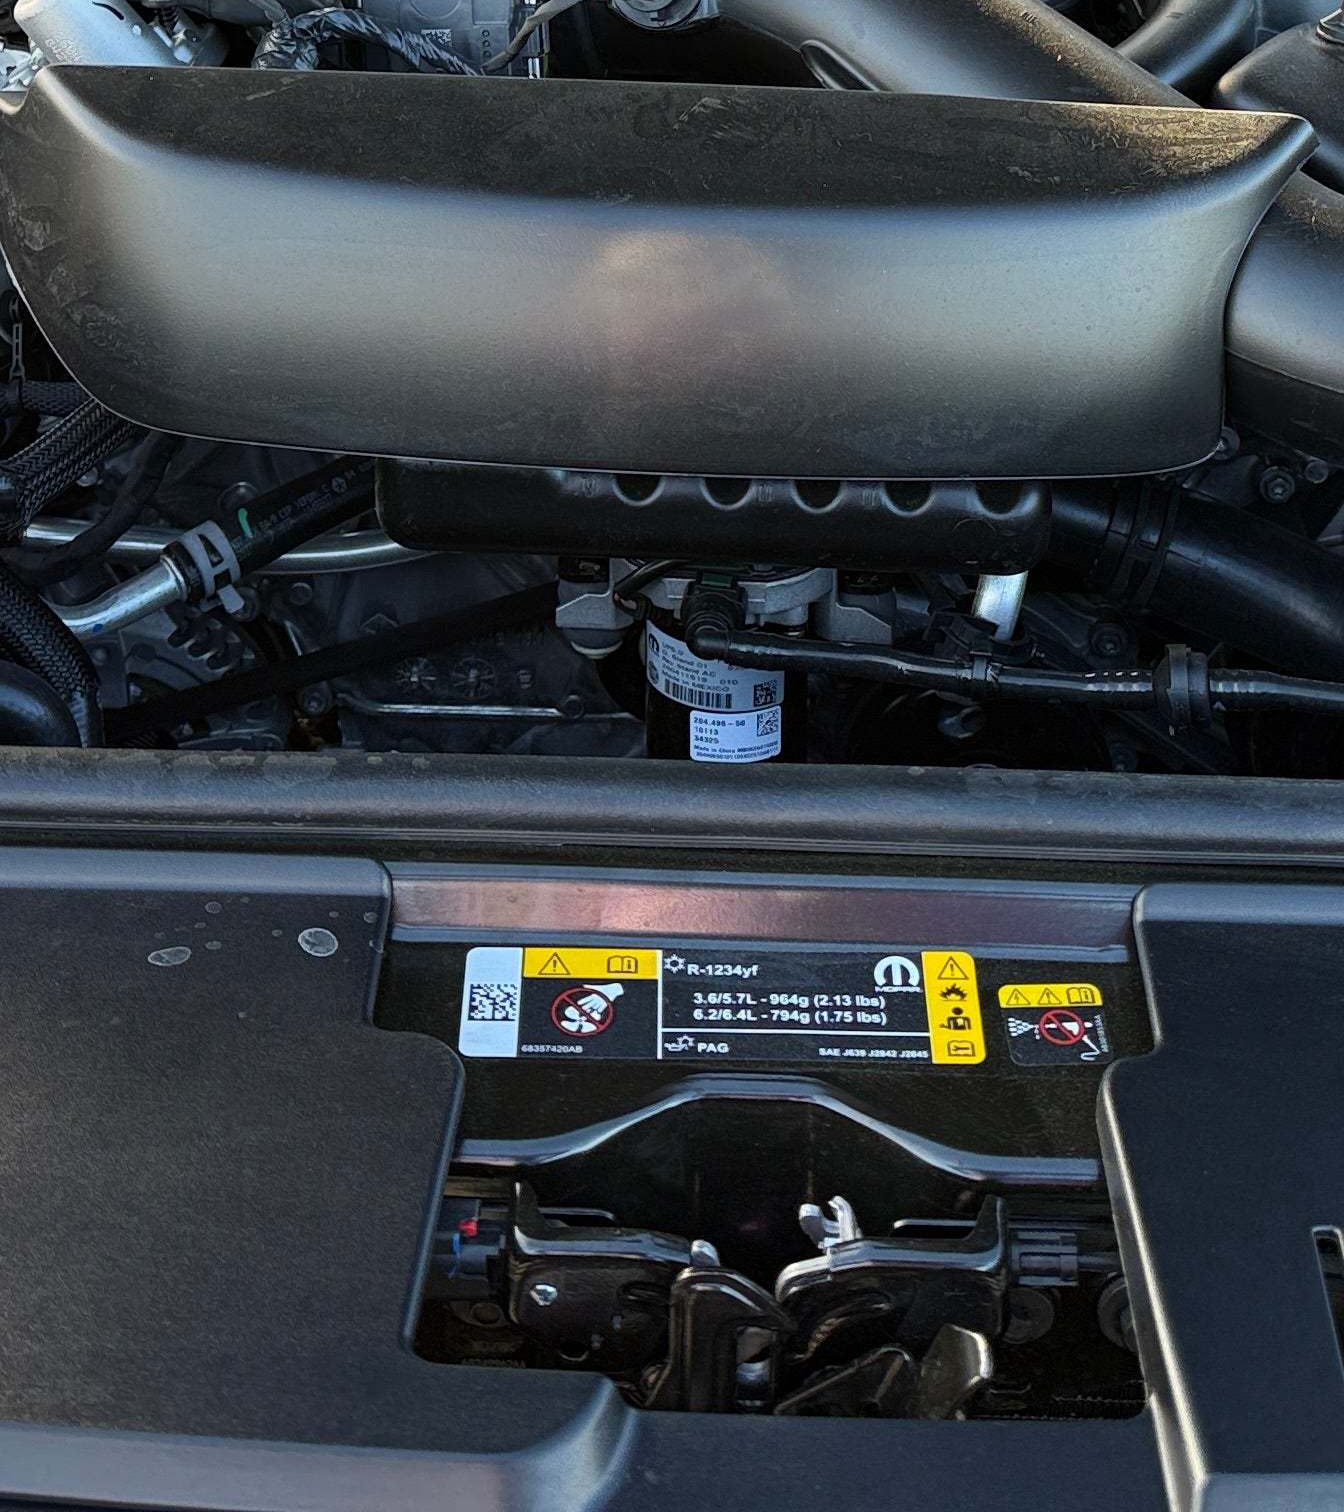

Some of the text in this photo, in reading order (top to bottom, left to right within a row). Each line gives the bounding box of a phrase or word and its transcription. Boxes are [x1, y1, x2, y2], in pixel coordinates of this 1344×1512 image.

[687, 963, 759, 979] R-1234yf
[693, 992, 757, 1006] 3.6/5.7L
[769, 994, 809, 1009] 964g
[813, 994, 852, 1008] (2.13
[855, 996, 886, 1010] lbs)
[693, 1009, 758, 1022] 6.2/6.4L
[770, 1010, 810, 1025] 794g
[814, 1011, 853, 1025] (1.75
[856, 1012, 888, 1026] lbs)
[697, 1042, 729, 1054] PAG
[818, 1048, 841, 1056] SAE
